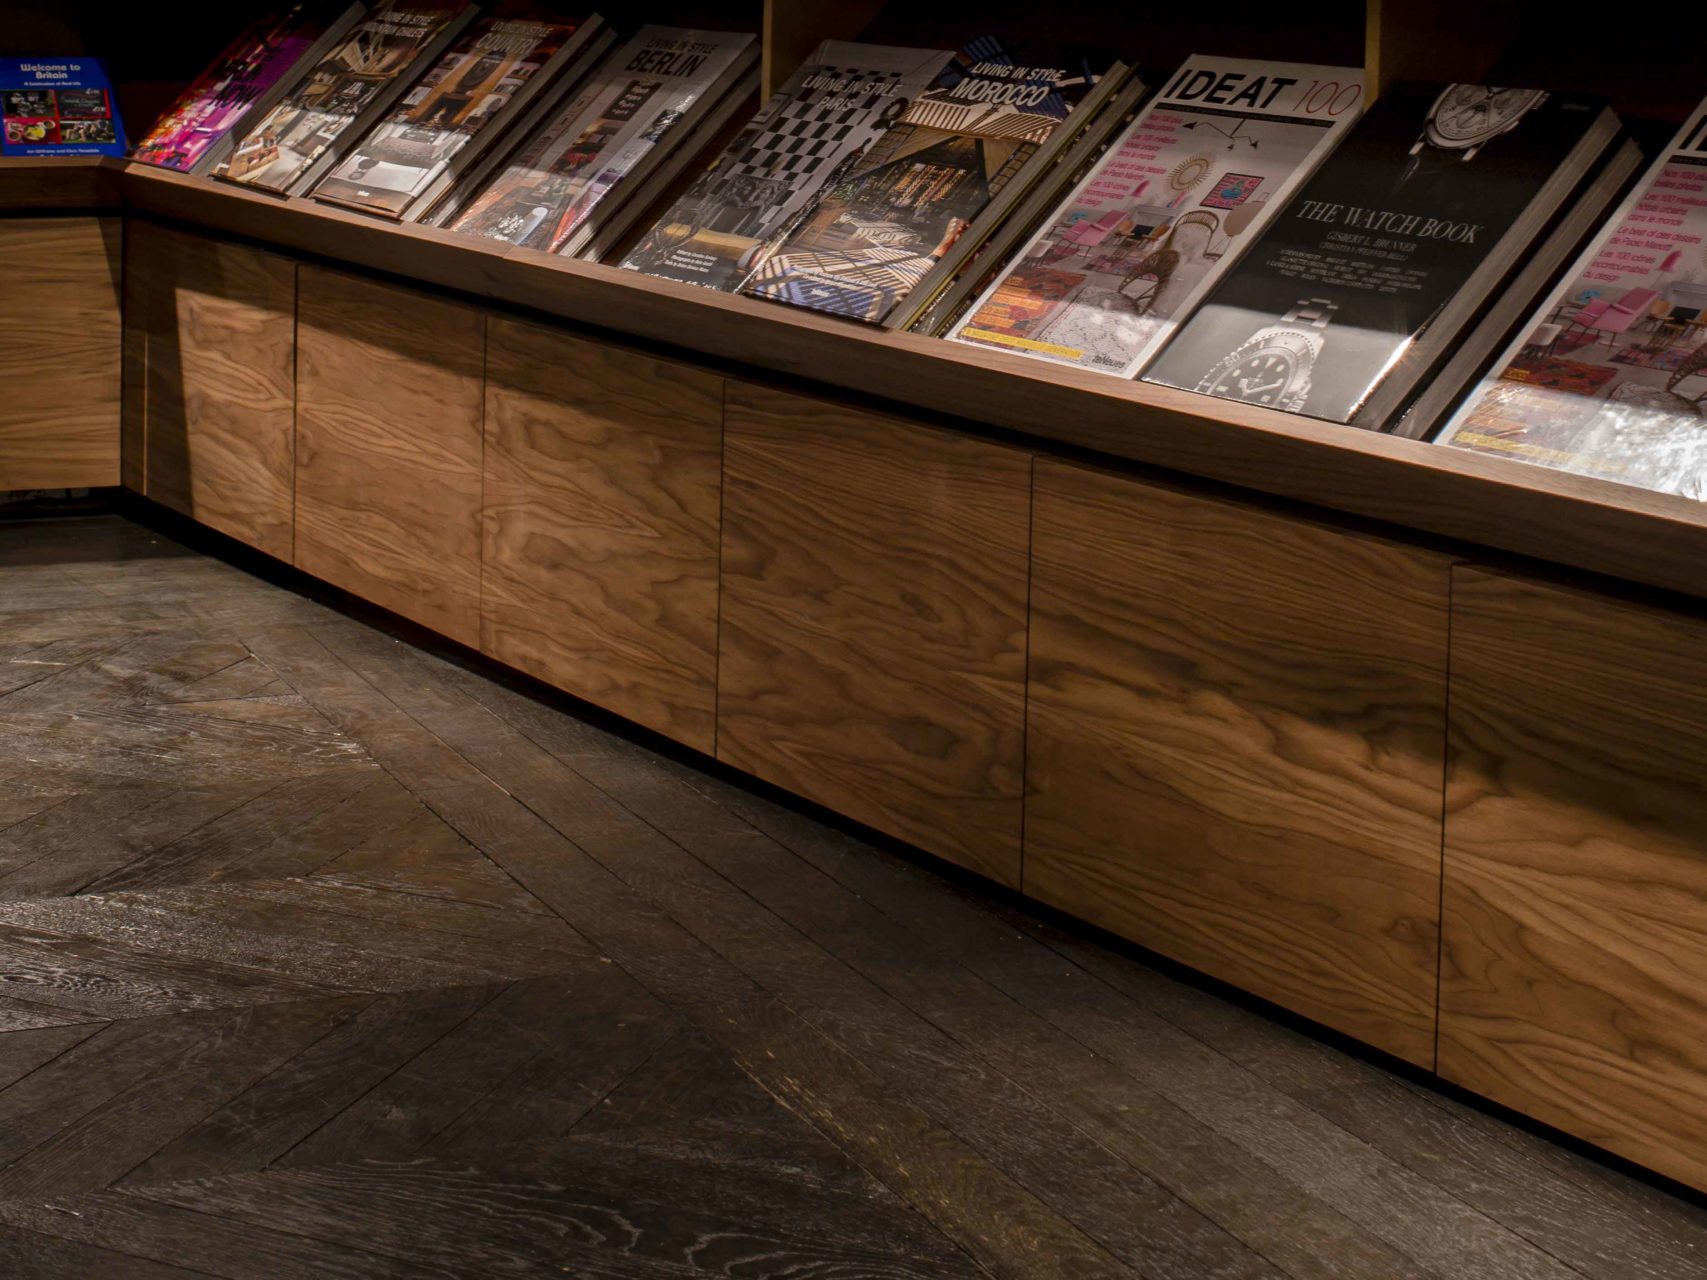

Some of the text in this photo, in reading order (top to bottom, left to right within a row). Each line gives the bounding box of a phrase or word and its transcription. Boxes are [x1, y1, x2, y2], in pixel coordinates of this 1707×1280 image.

[475, 32, 542, 57] COUNTRY
[688, 42, 718, 54] STYLE
[20, 64, 67, 72] Welcome
[35, 71, 68, 79] Britain
[625, 50, 708, 77] BERLIN
[971, 61, 1067, 81] LIVING IN STYLE
[801, 74, 904, 97] LIVING IN STYLE
[949, 77, 1050, 107] MOROCCO
[1164, 69, 1298, 108] IDEAT
[1293, 80, 1361, 116] 100
[816, 96, 857, 111] PARIS
[1296, 200, 1485, 244] THE WATCH BOOK
